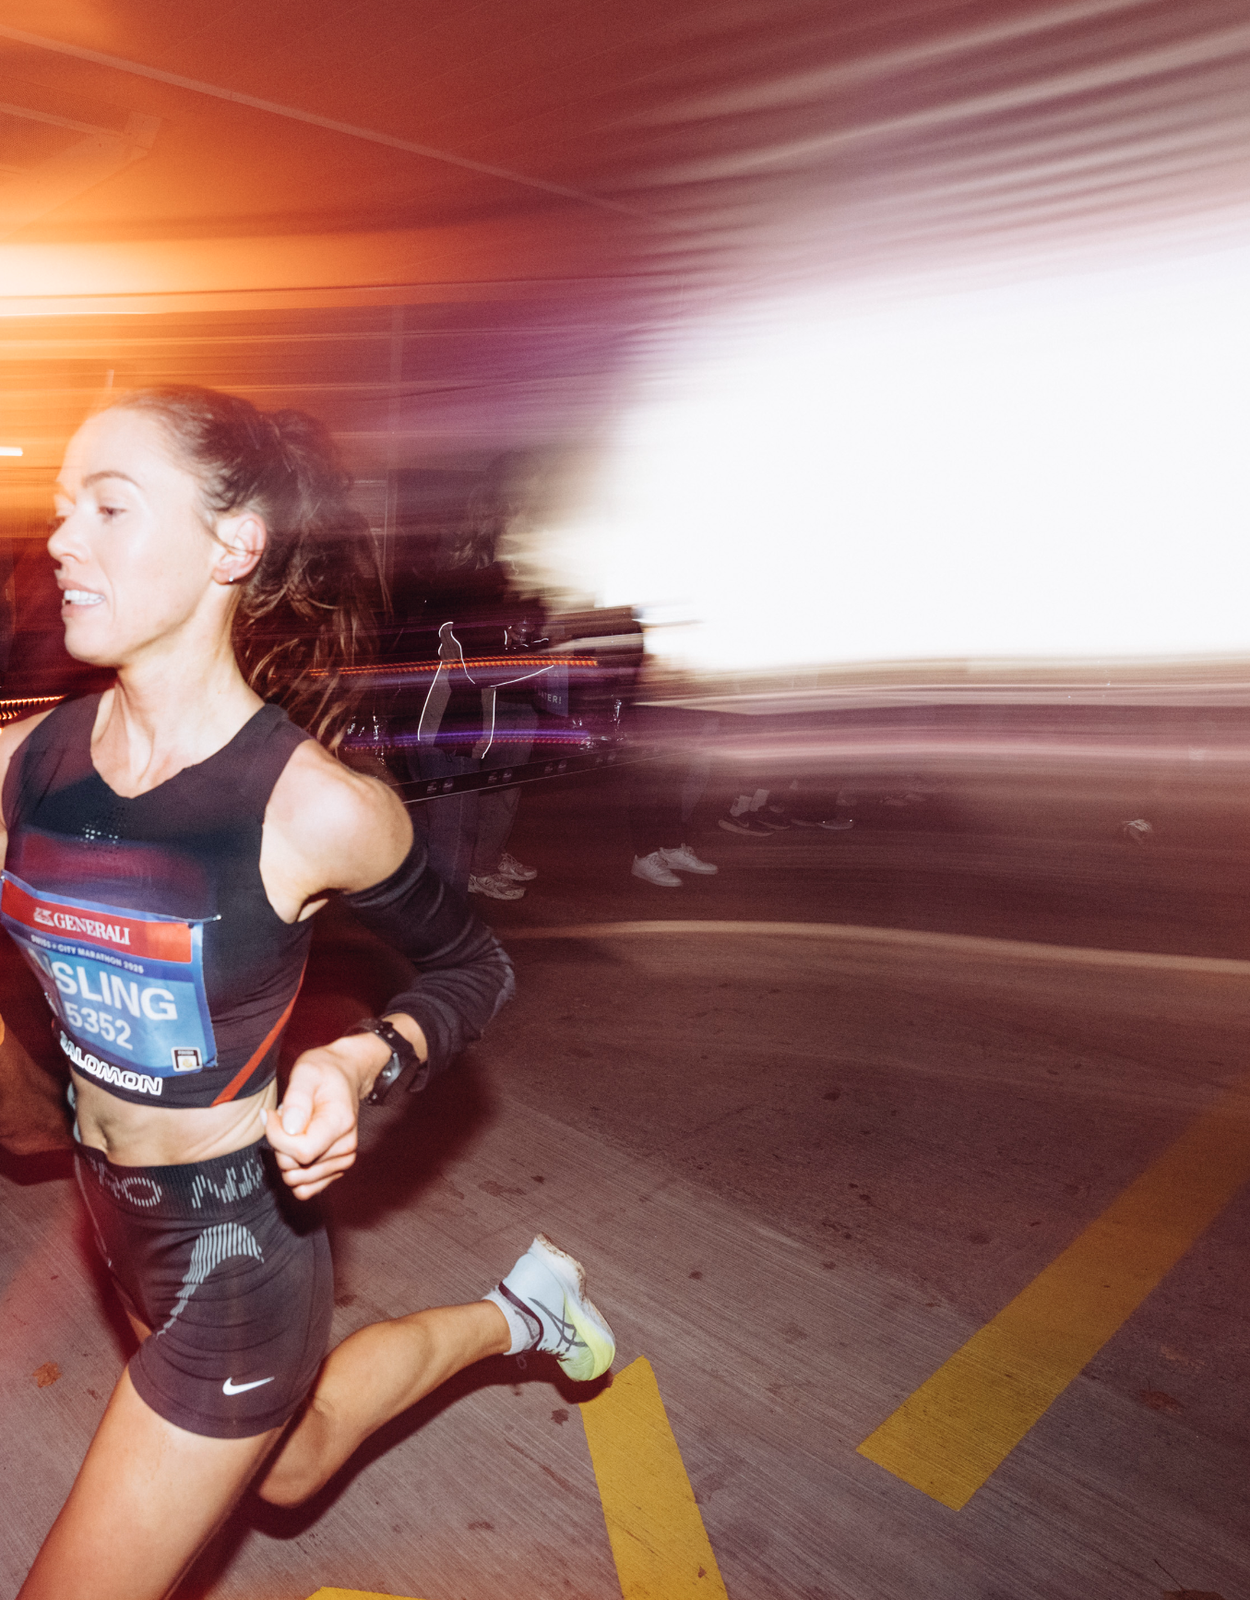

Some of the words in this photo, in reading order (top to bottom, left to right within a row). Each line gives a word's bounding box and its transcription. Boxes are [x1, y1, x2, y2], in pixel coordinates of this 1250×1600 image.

[53, 912, 131, 946] GENERALI
[57, 944, 76, 955] CITY
[77, 947, 122, 967] MARATHON
[64, 1001, 133, 1051] 5352
